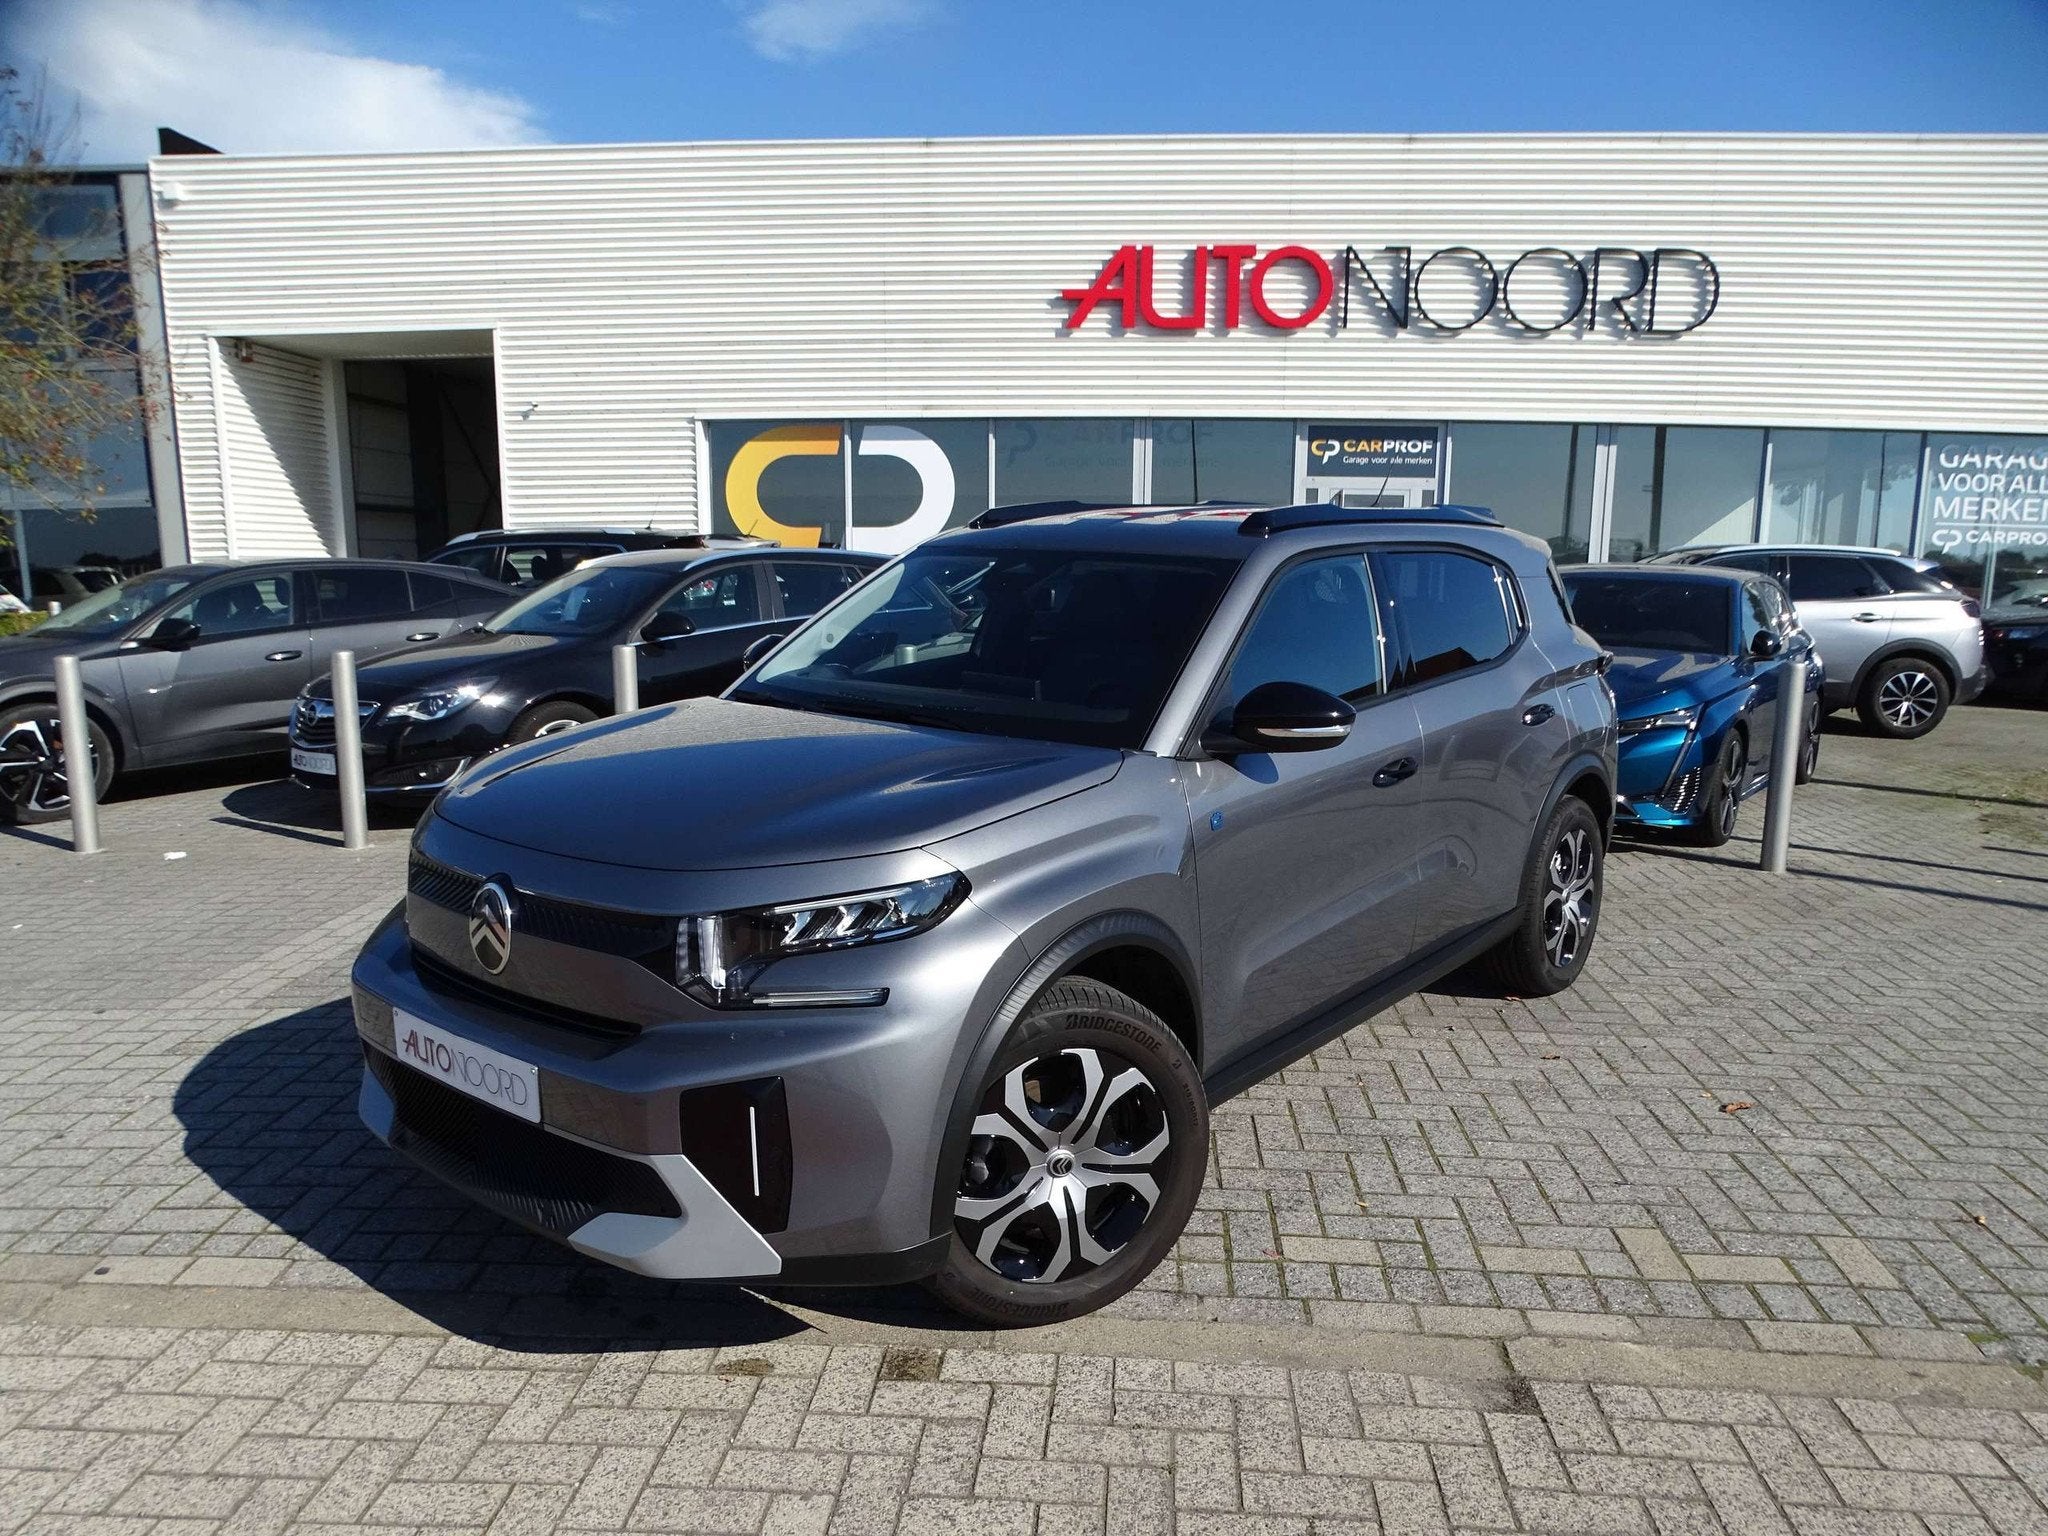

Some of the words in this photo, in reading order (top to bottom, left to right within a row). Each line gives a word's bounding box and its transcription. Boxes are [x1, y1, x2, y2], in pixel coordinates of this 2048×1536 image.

[1343, 439, 1433, 453] CARPROF
[1343, 456, 1369, 465] Garage
[1405, 456, 1433, 465] merken
[1938, 472, 2005, 493] VOOR
[1065, 1014, 1161, 1053] BRIDGESTONE
